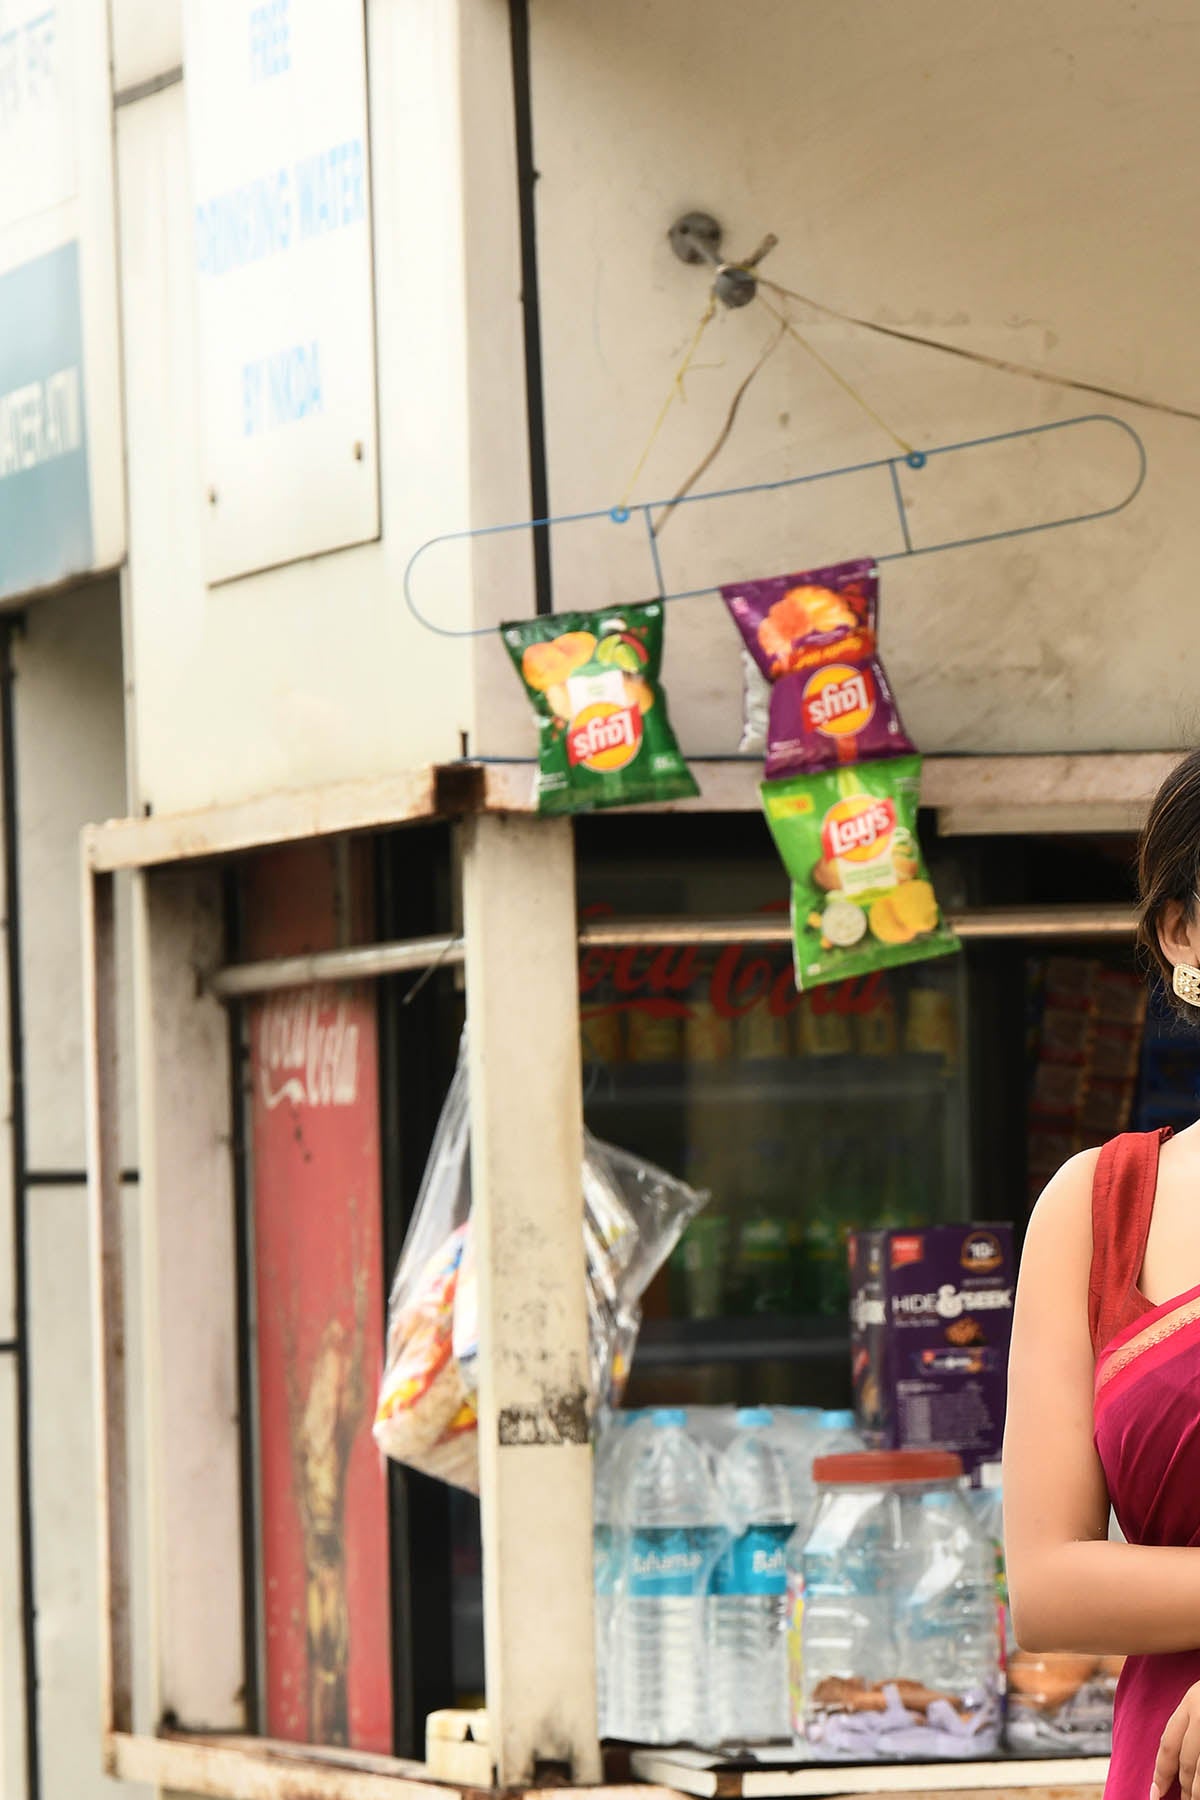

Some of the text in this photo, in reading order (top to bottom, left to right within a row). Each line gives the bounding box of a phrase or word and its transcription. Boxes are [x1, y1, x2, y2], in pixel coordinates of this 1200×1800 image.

[297, 138, 363, 240] WATER
[807, 673, 868, 727] Lay's
[828, 804, 891, 855] Lay's
